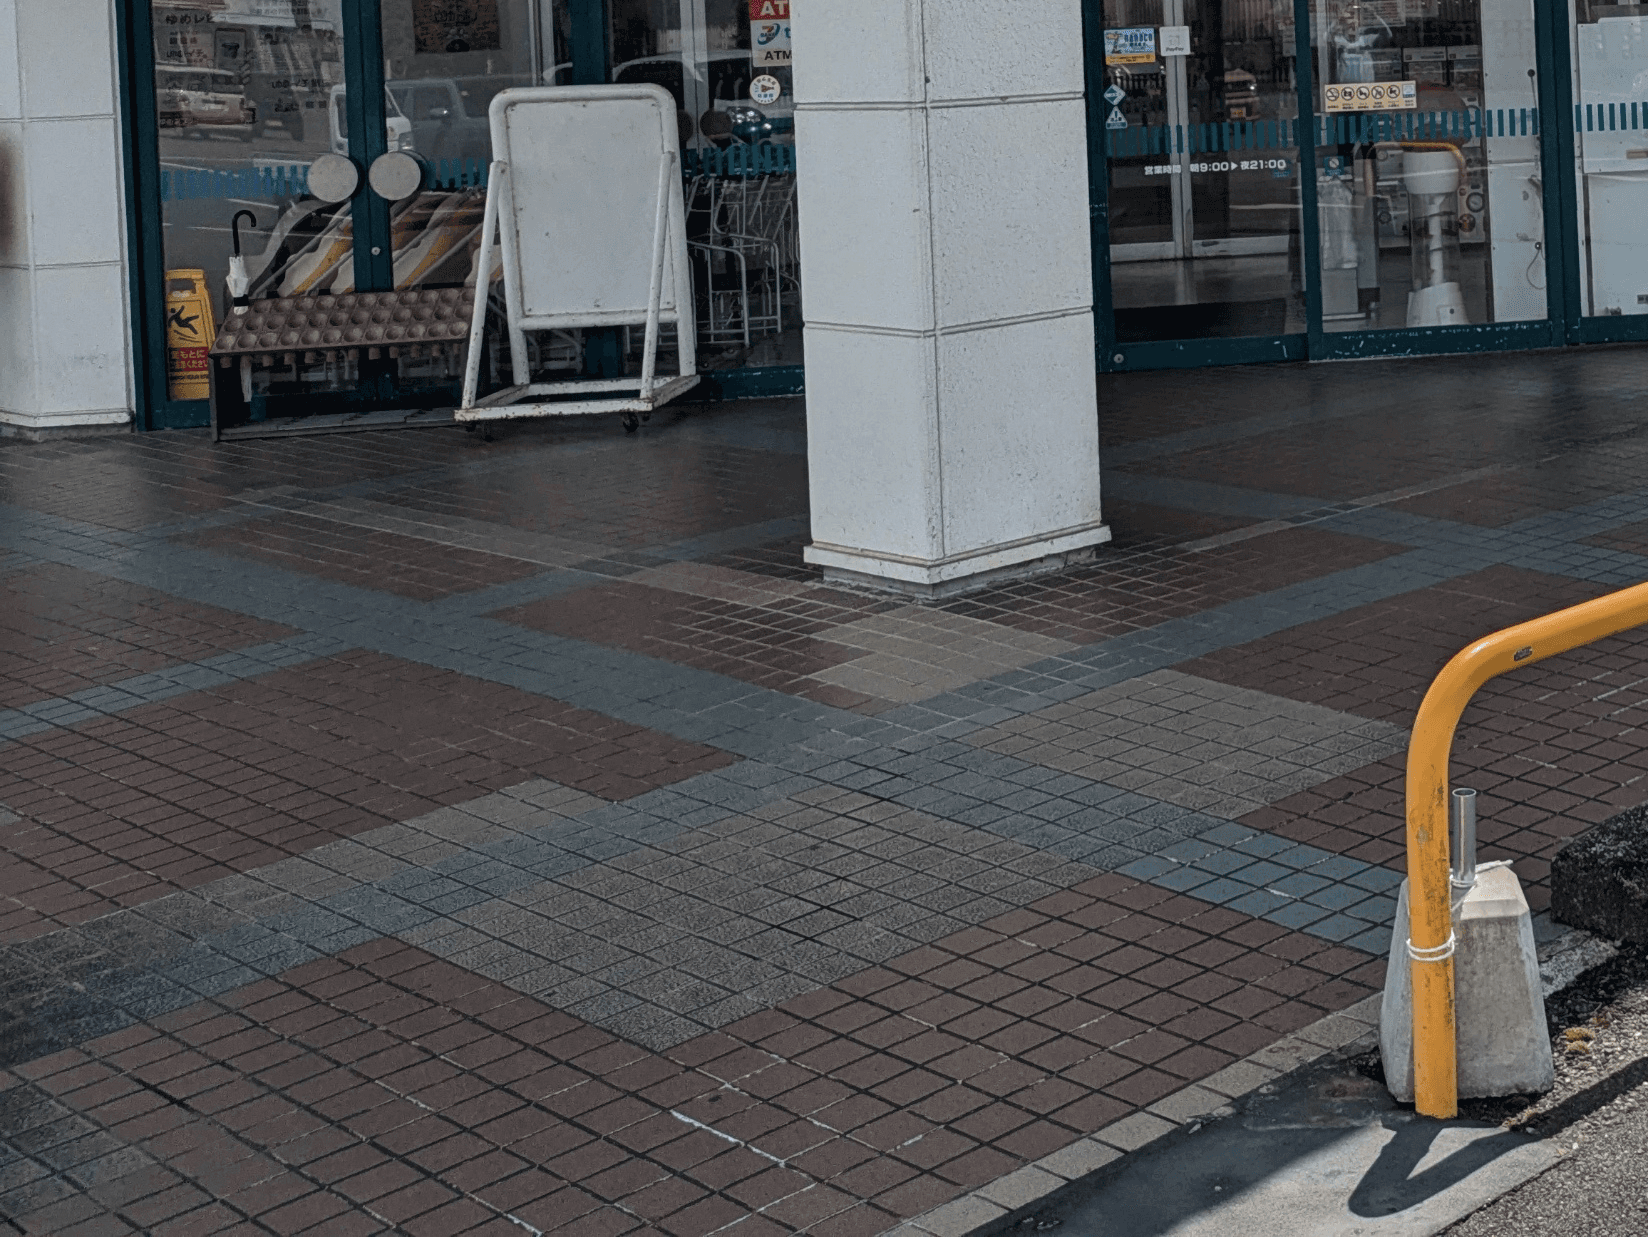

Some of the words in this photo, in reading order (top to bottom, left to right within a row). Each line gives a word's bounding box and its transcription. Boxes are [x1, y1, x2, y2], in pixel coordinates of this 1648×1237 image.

[760, 0, 789, 16] AT
[1144, 164, 1182, 176] 営業時間
